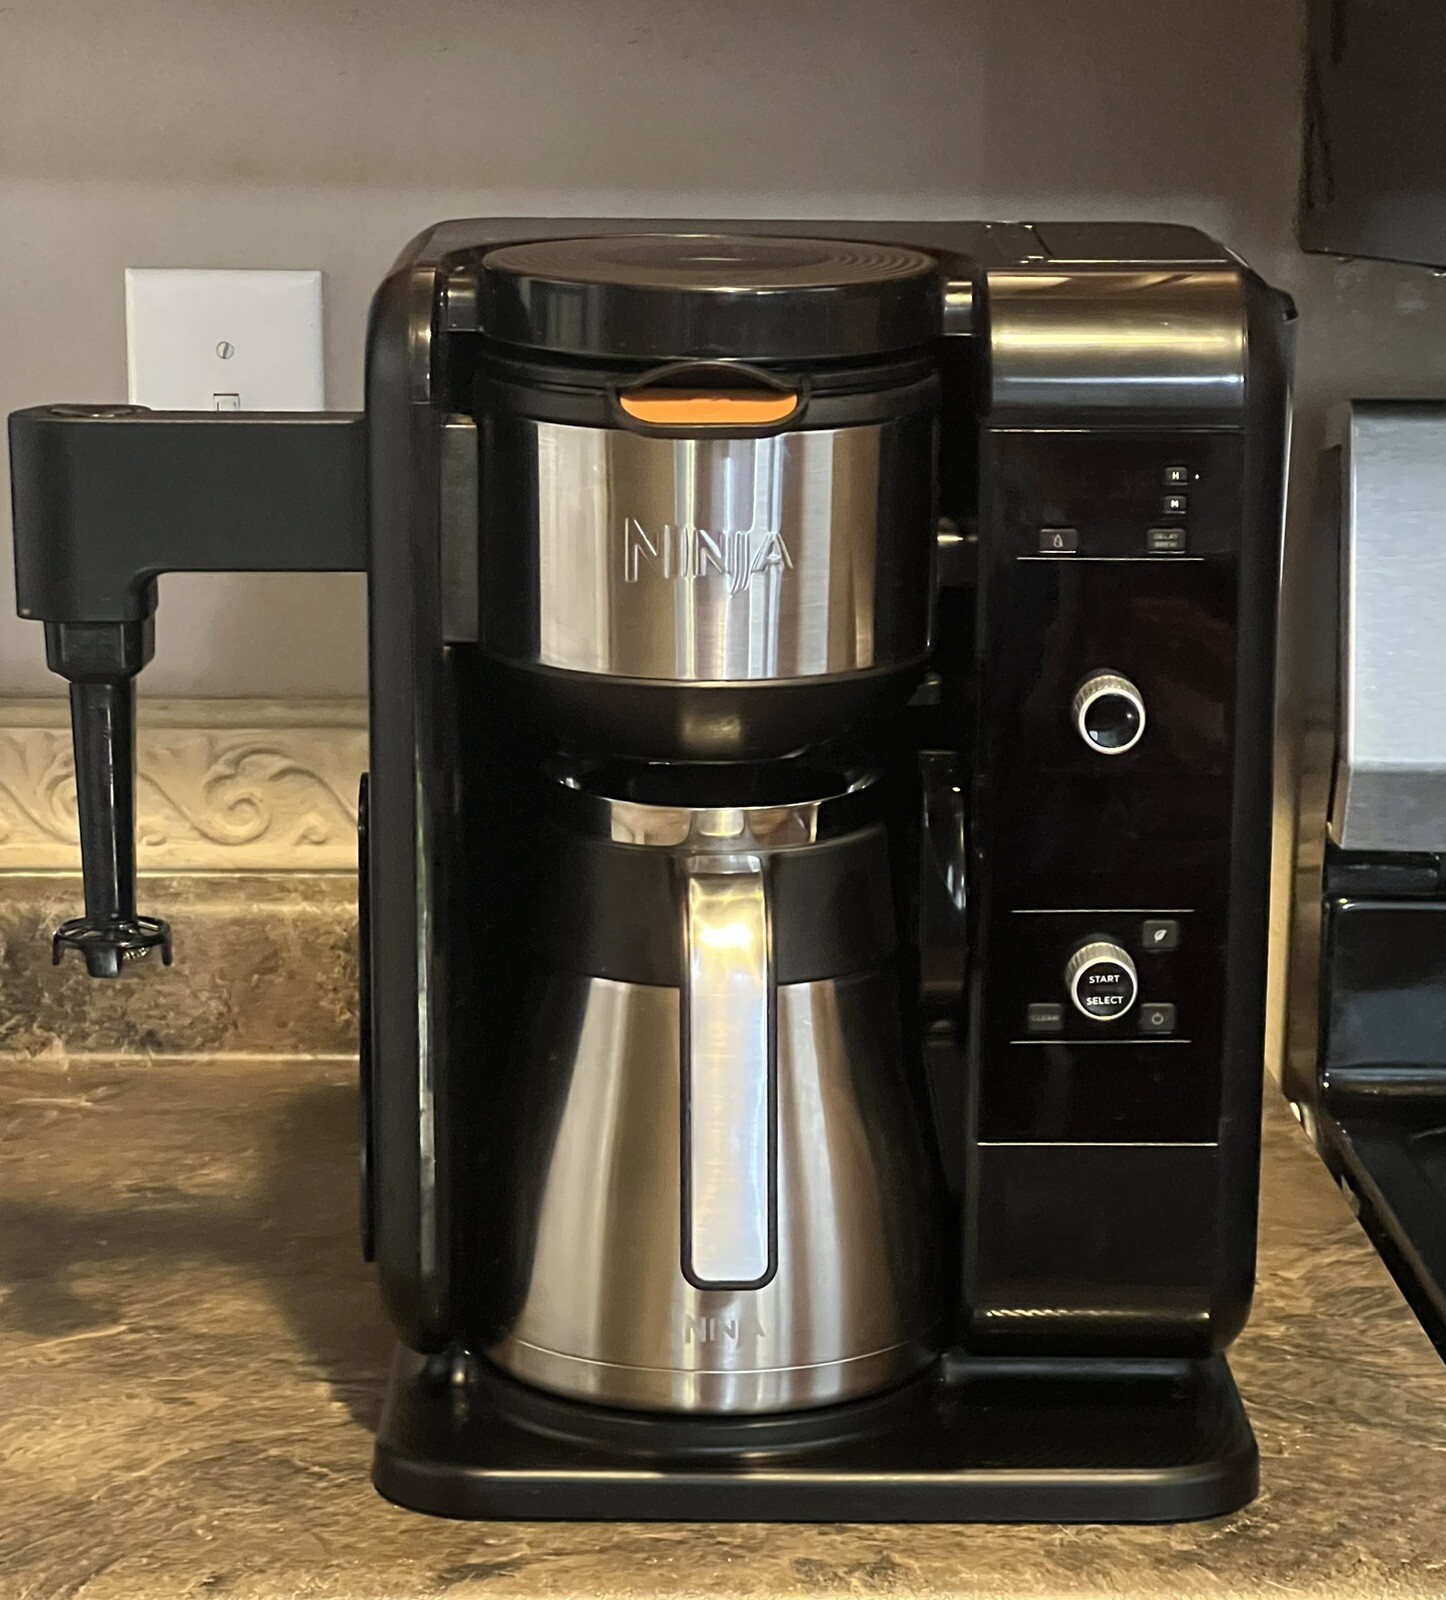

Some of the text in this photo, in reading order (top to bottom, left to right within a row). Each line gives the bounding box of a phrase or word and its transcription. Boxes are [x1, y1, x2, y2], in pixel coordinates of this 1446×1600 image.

[624, 516, 794, 599] NINJA
[1088, 974, 1120, 984] START
[1086, 996, 1124, 1006] SELECT
